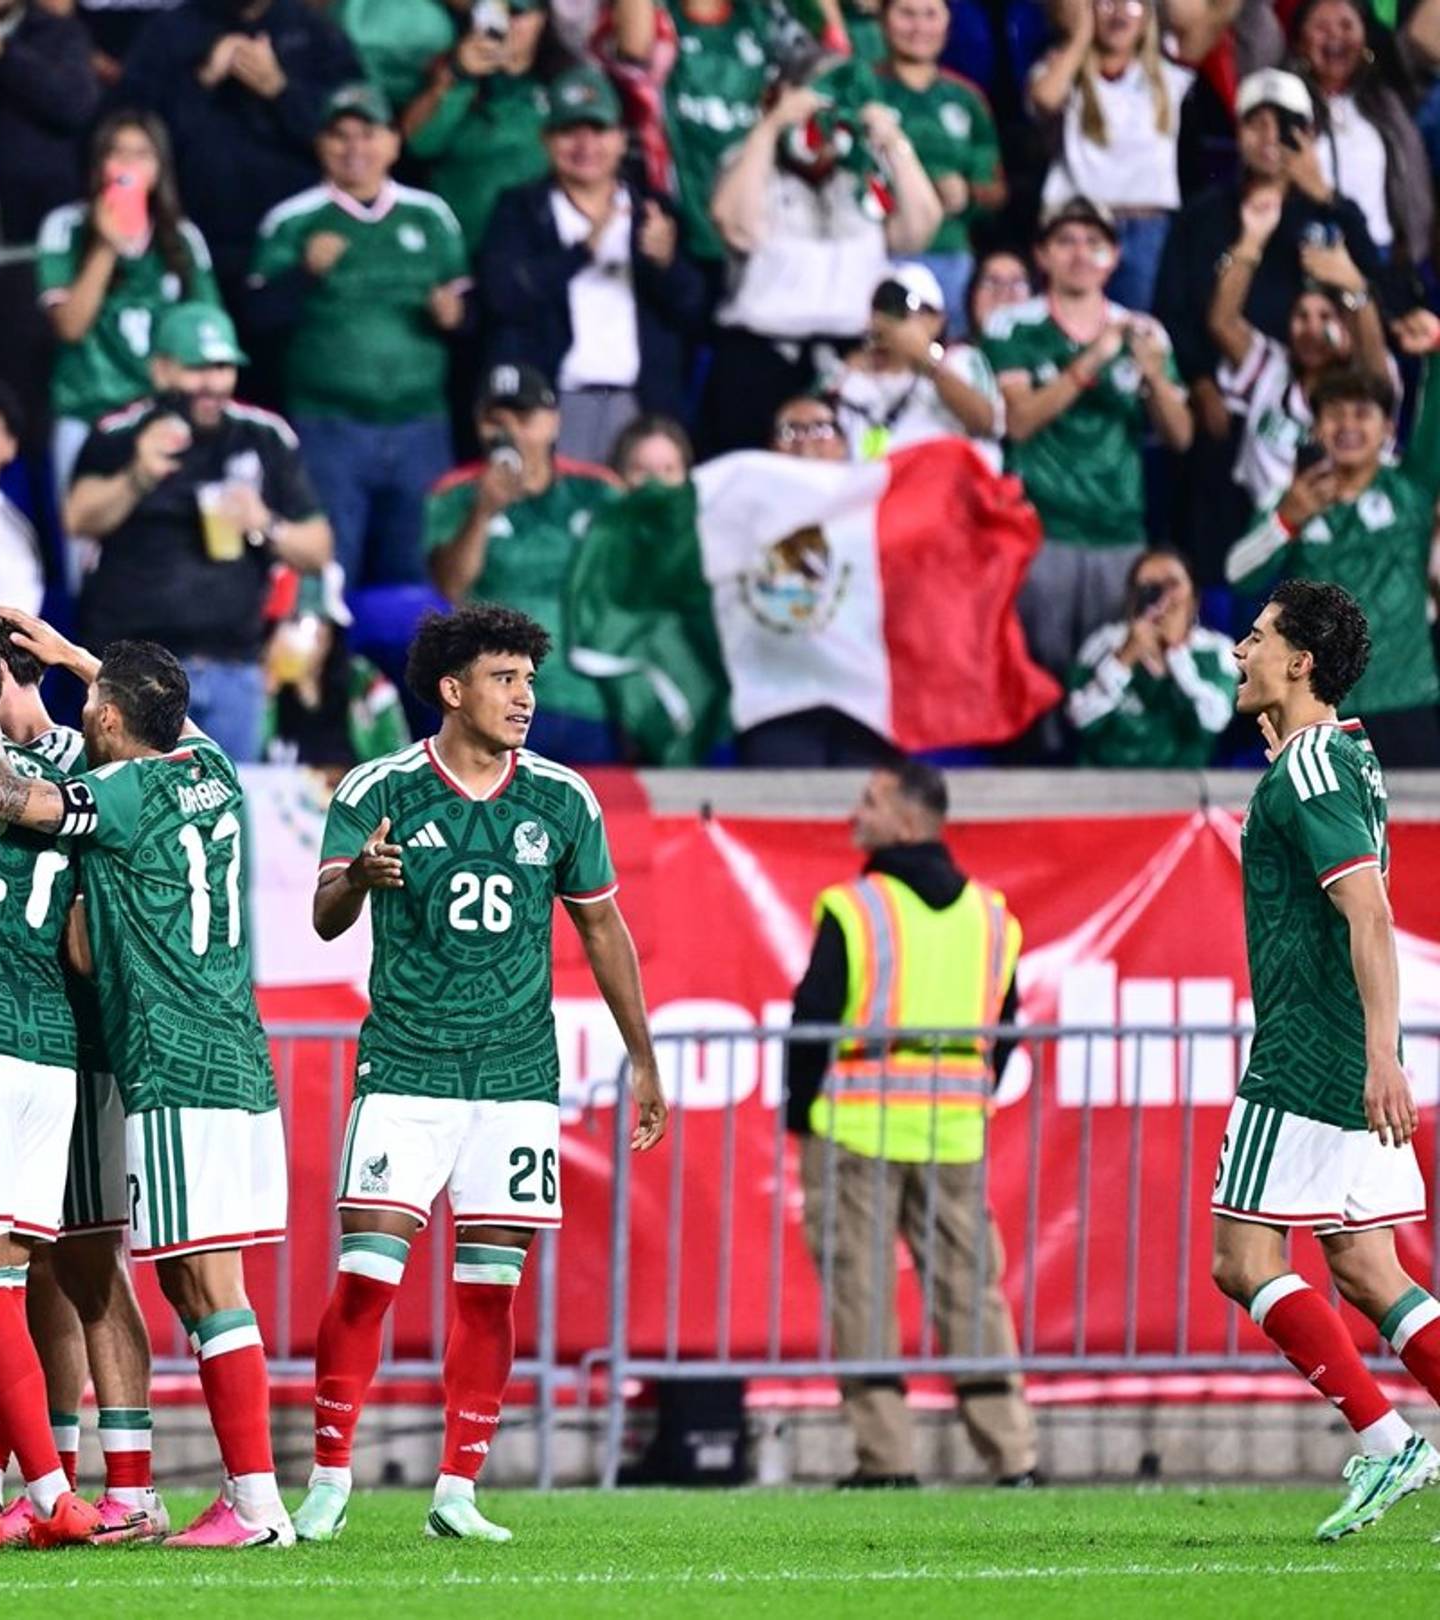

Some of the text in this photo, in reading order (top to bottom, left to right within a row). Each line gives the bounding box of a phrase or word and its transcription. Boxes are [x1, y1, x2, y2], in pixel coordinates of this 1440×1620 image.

[66, 782, 95, 806] C
[178, 811, 241, 956] 17
[448, 871, 514, 933] 26
[509, 1146, 556, 1204] 26
